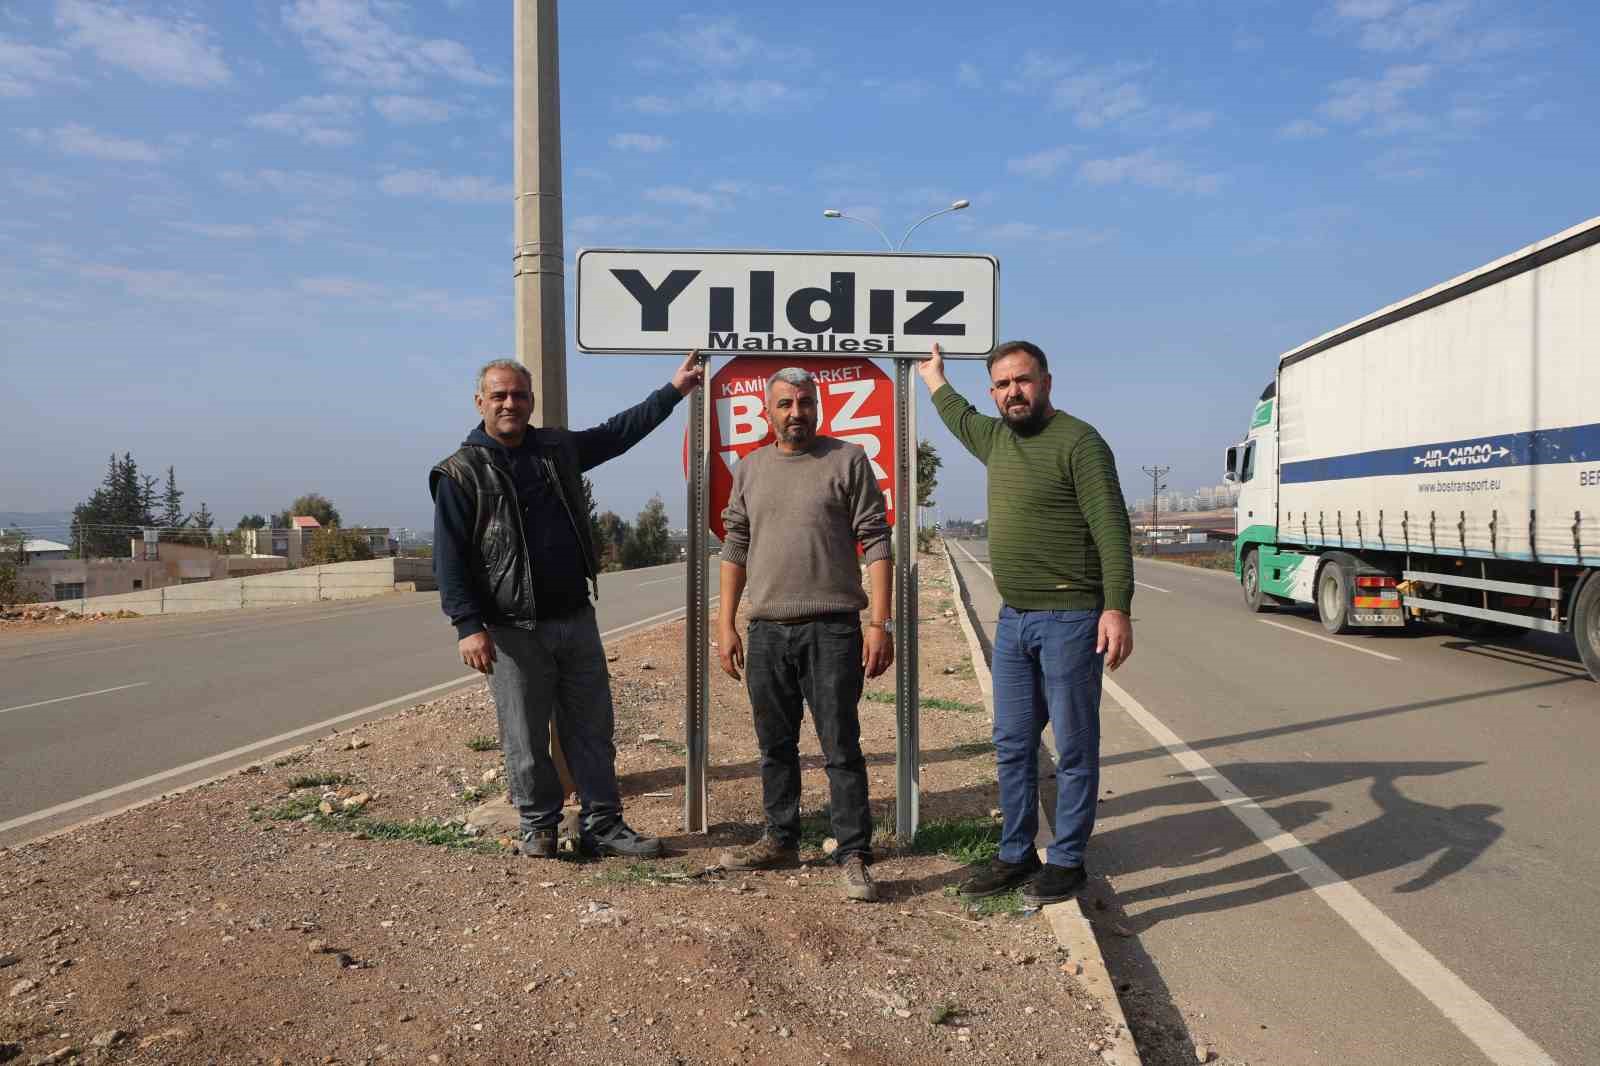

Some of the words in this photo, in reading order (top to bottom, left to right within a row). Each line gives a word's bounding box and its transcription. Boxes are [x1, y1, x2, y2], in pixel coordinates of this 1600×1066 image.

[609, 269, 966, 336] Yıldız
[709, 332, 895, 351] Mahallesi
[811, 365, 863, 384] ARKET
[716, 378, 882, 447] BZ
[1424, 450, 1442, 468] AIR
[1447, 443, 1492, 467] CARGO
[1418, 478, 1502, 495] www.bostransport.eu
[1353, 614, 1400, 622] VOLVO
